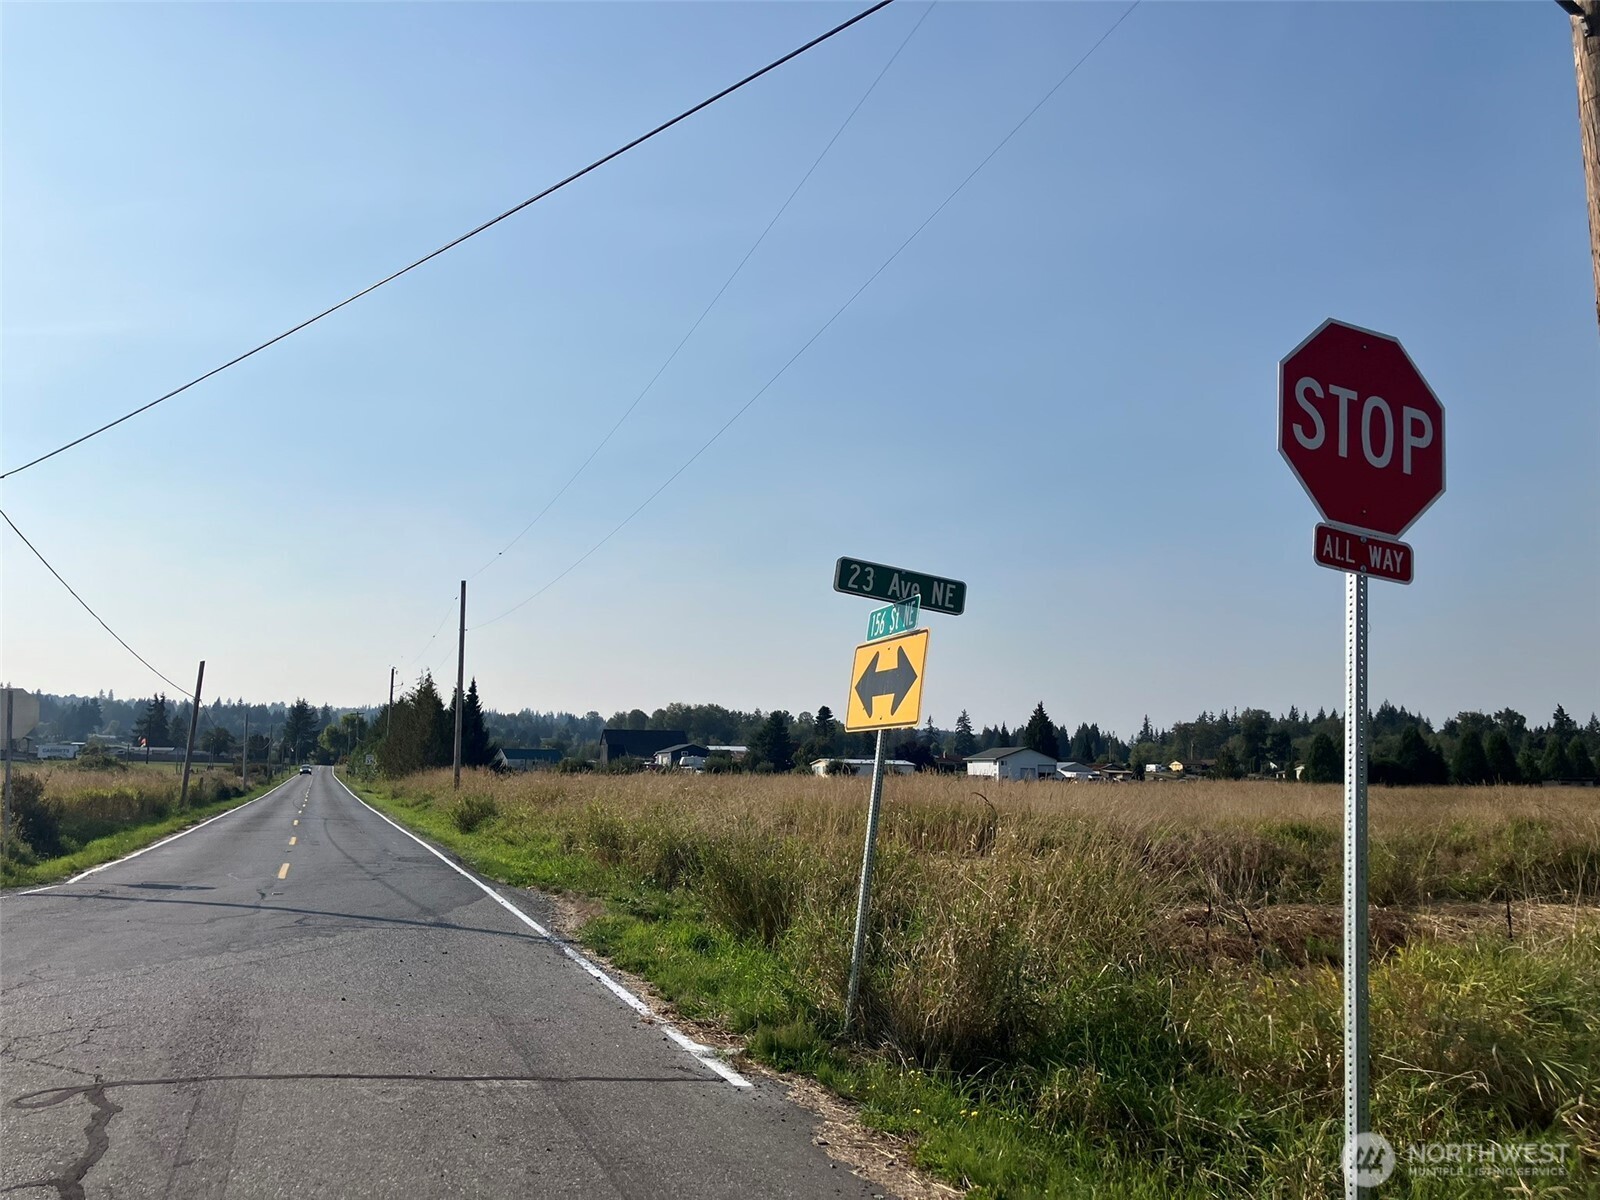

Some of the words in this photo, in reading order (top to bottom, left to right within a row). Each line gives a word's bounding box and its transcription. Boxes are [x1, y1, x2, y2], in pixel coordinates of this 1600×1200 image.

[1292, 376, 1434, 475] STOP
[1322, 534, 1356, 564] ALL
[1368, 544, 1404, 573] WAY
[847, 563, 875, 592] 23
[887, 572, 920, 599] Ave
[931, 580, 956, 608] NE
[870, 611, 887, 637] 156
[889, 606, 900, 633] St
[903, 600, 916, 628] NE
